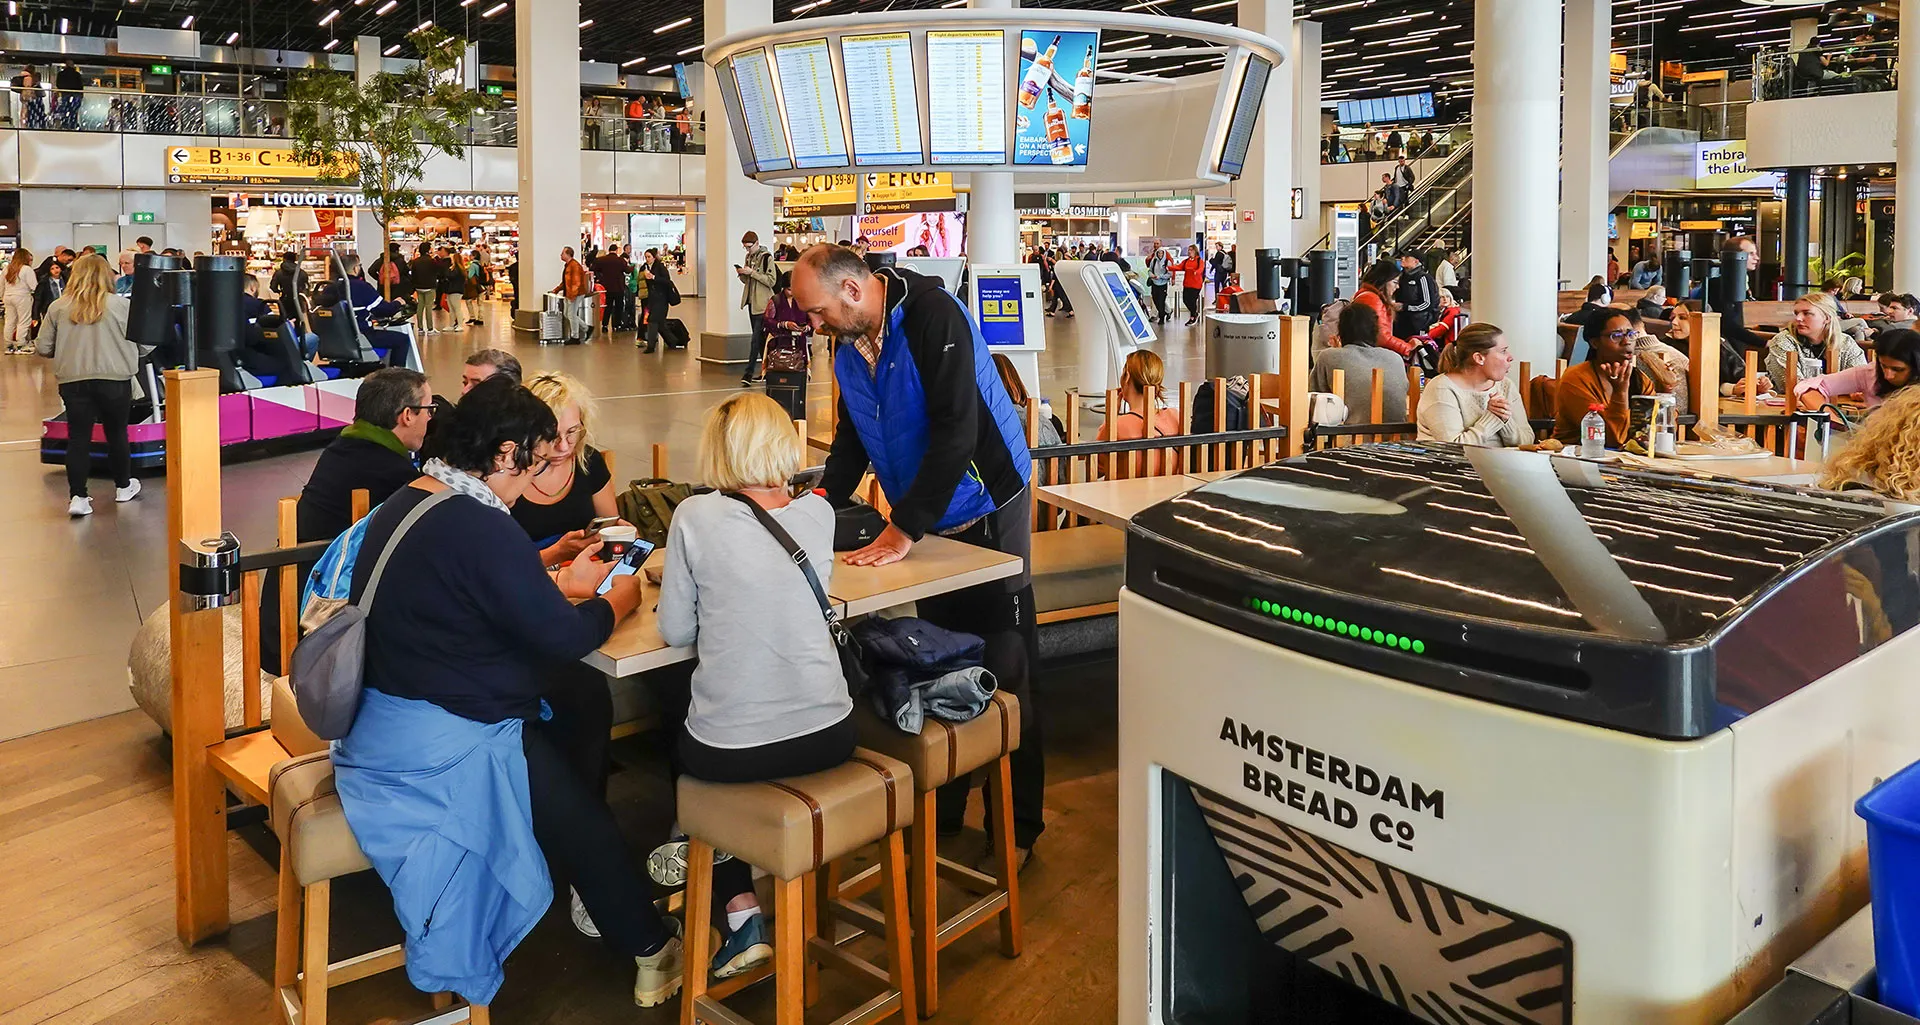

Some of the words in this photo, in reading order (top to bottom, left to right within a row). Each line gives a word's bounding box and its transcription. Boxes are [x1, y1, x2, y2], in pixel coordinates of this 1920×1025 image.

[209, 149, 222, 165] B
[226, 151, 251, 162] 1-36
[258, 150, 271, 166] C
[1702, 148, 1747, 161] Embra
[1708, 163, 1730, 175] the
[824, 174, 833, 192] D
[835, 173, 856, 186] 59-87
[264, 192, 328, 206] LIQUOR
[432, 194, 519, 208] CHOCOLATE
[1070, 206, 1110, 217] COSMETIC
[860, 226, 898, 237] yourself
[1219, 716, 1445, 820] AMSTERDAM
[1243, 761, 1359, 829] BREAD
